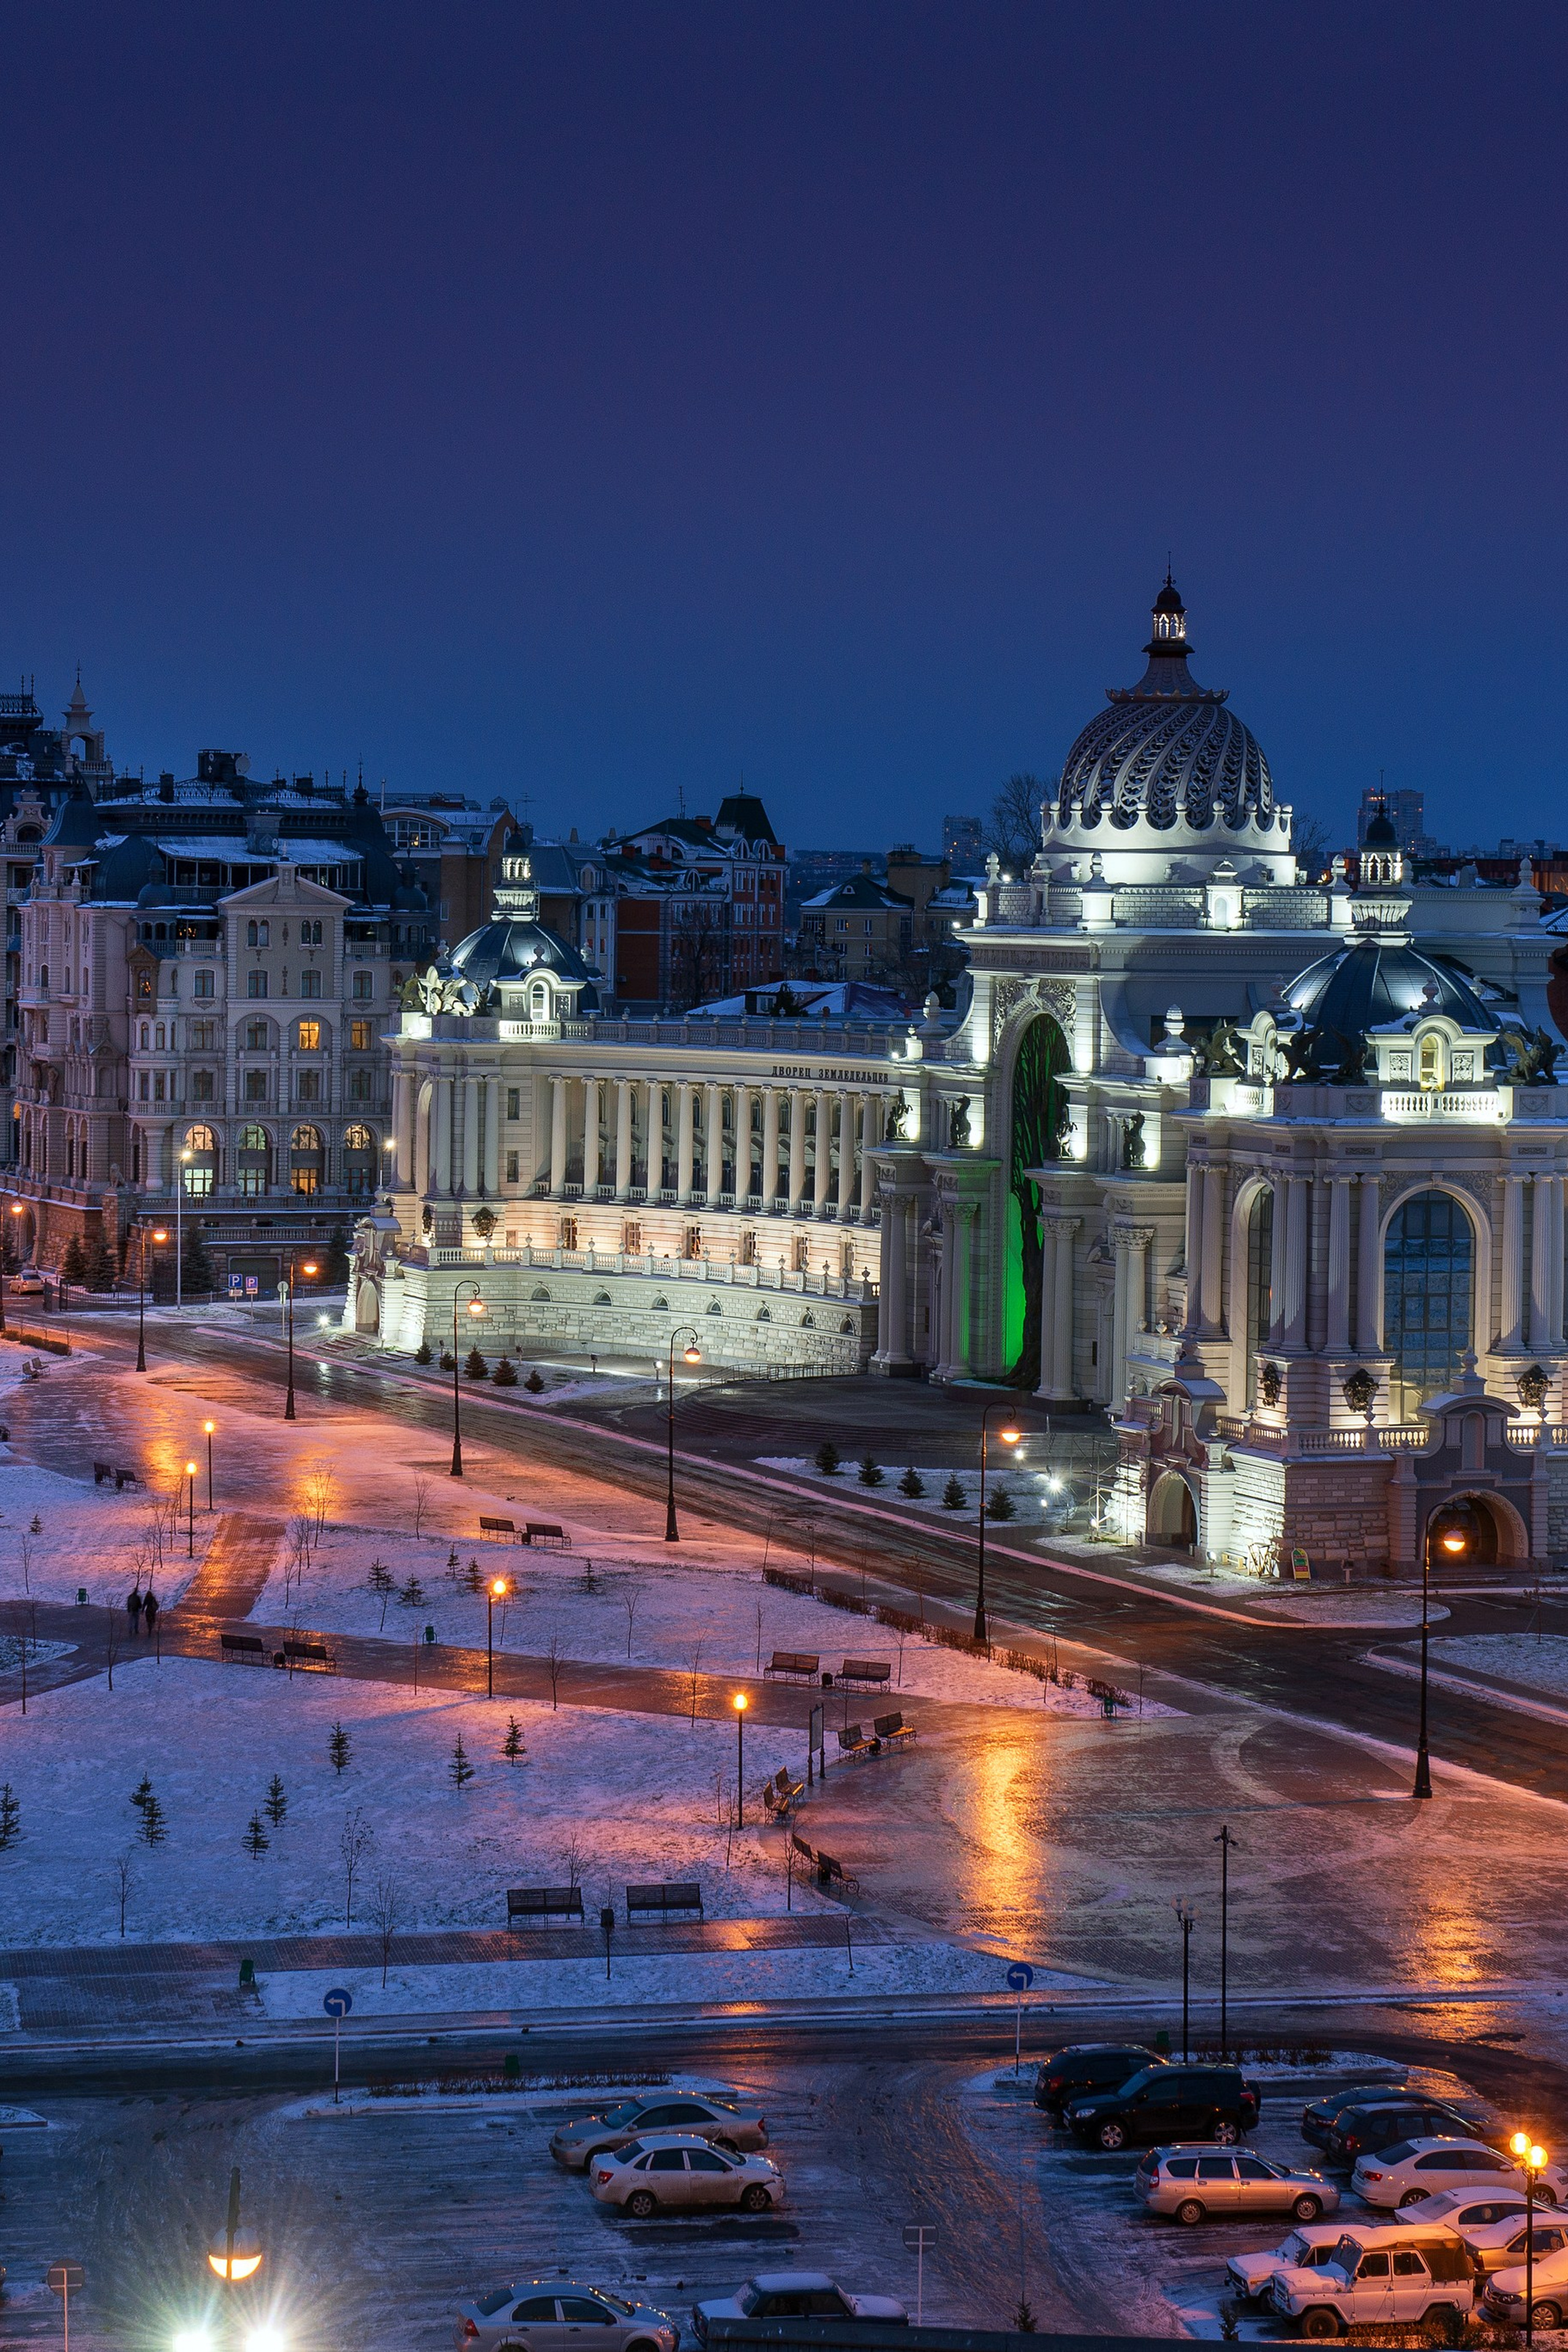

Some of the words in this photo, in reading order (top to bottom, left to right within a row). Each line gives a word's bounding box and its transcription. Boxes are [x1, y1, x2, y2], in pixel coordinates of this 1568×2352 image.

[772, 1066, 811, 1078] ДВОРЕЦ
[818, 1069, 888, 1084] ЗЕМЛЕДЕЛЬЦЕВ
[232, 1276, 239, 1286] P
[248, 1278, 255, 1287] P
